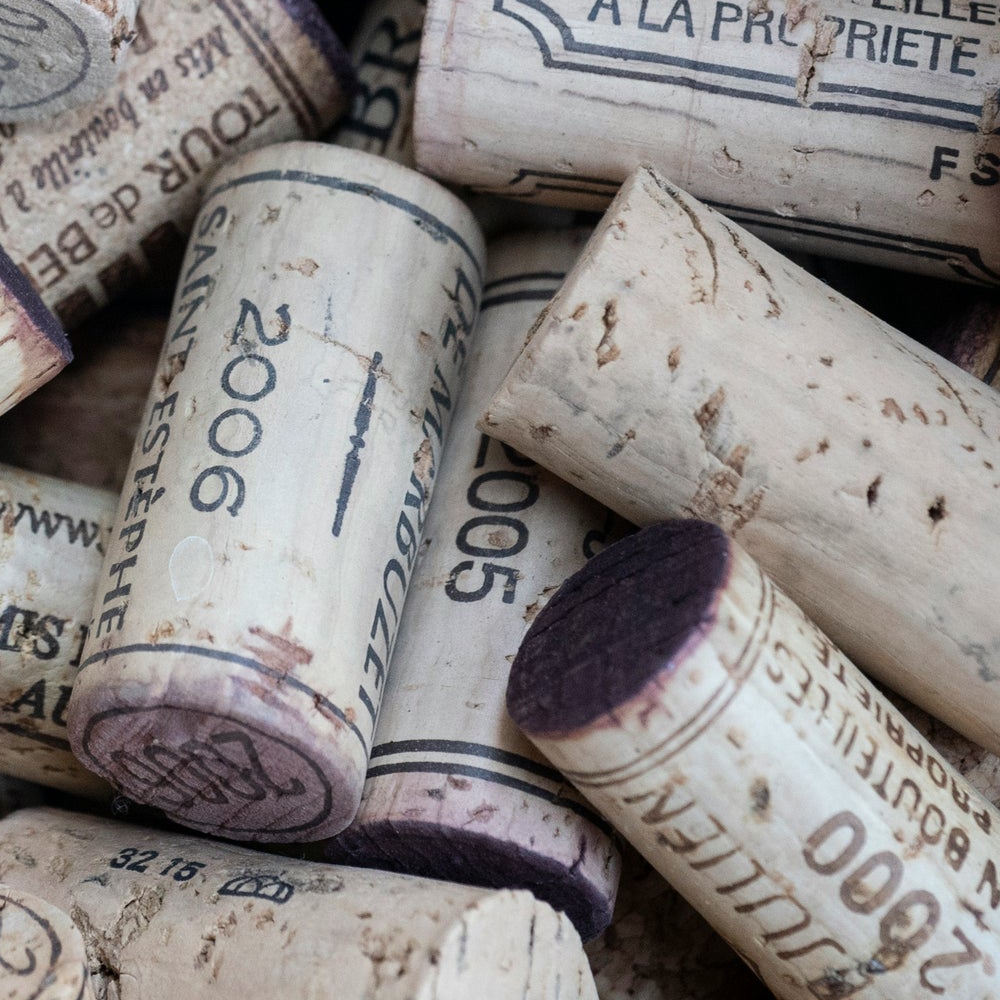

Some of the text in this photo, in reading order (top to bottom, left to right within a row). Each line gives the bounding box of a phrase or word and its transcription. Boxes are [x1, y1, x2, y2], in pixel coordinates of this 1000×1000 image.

[138, 68, 170, 102] en
[174, 25, 233, 80] Mis
[32, 90, 142, 194] bouteille
[142, 86, 280, 195] TOUR
[89, 183, 142, 230] de
[187, 298, 292, 519] 2006
[766, 639, 972, 873] BOUTEILLES
[110, 846, 149, 874] 32
[623, 773, 850, 962] JULIEN
[803, 810, 983, 995] 2000
